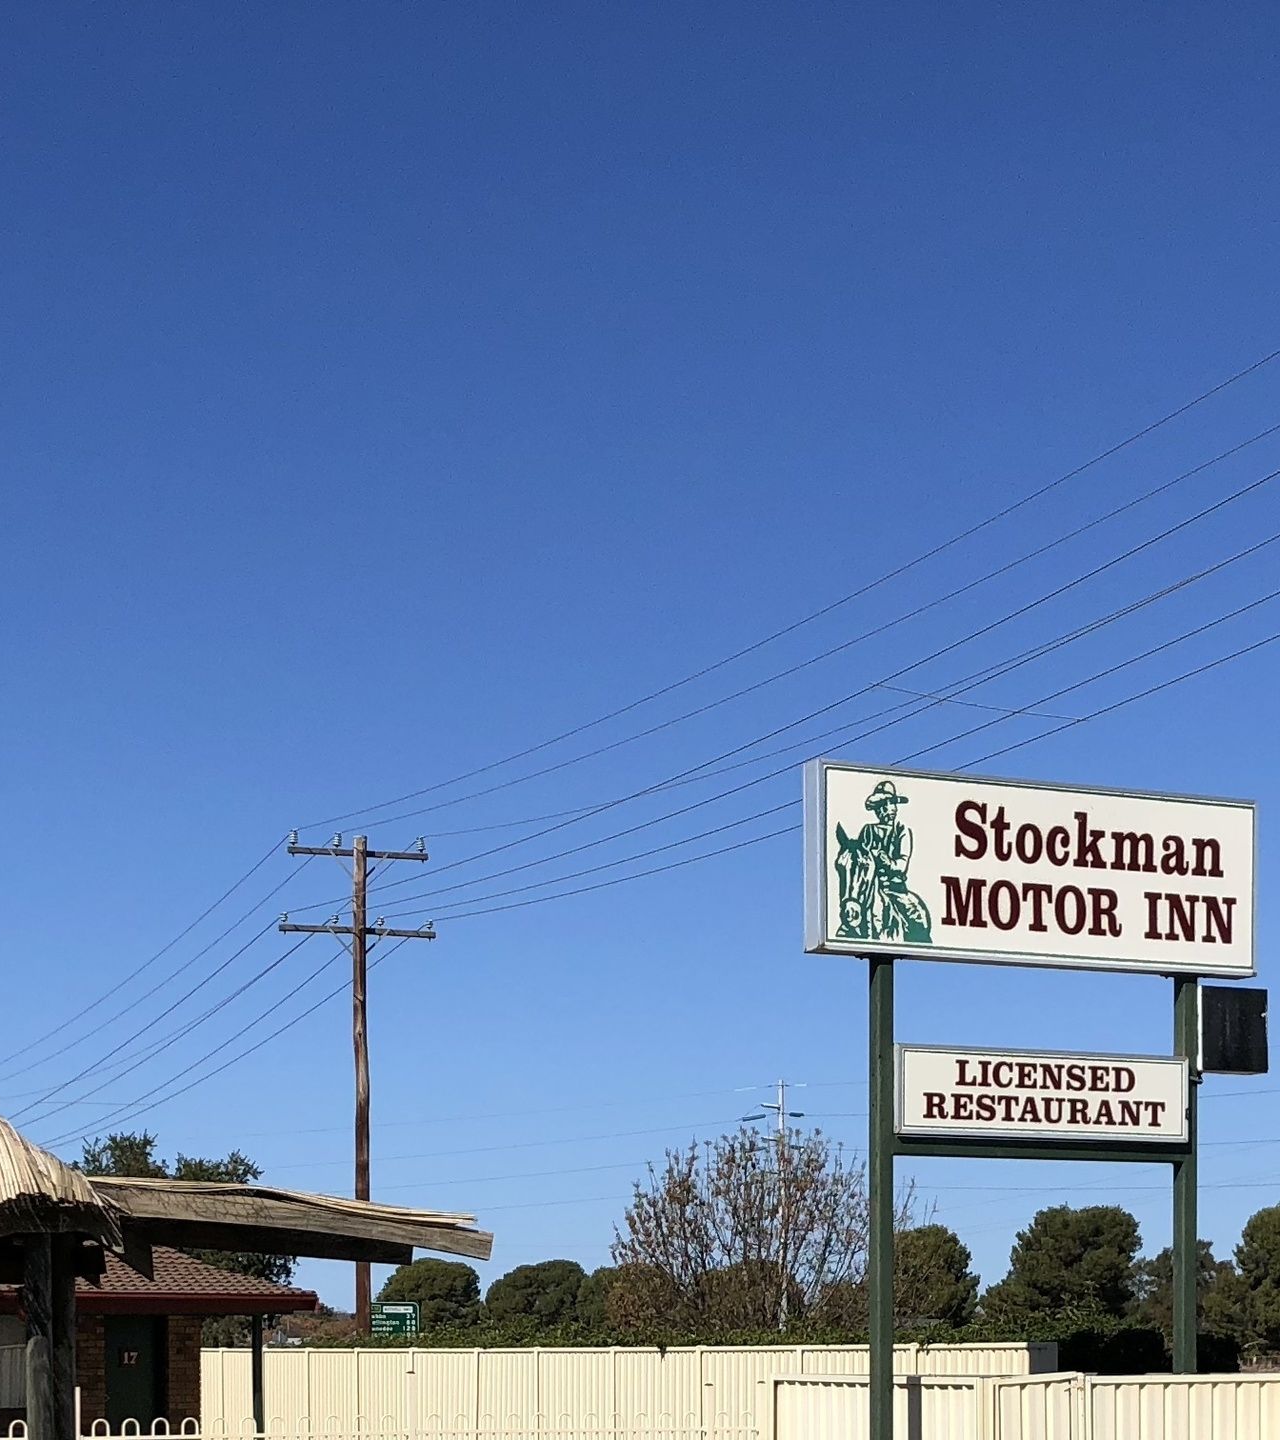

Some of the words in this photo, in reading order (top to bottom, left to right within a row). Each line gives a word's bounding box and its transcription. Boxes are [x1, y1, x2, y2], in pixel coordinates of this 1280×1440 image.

[954, 800, 1224, 878] Stockman
[940, 875, 1123, 938] MOTOR
[1143, 891, 1237, 945] INN
[955, 1059, 1136, 1093] LICENSED
[922, 1092, 1166, 1128] RESTAURANT
[123, 1351, 139, 1365] 17
